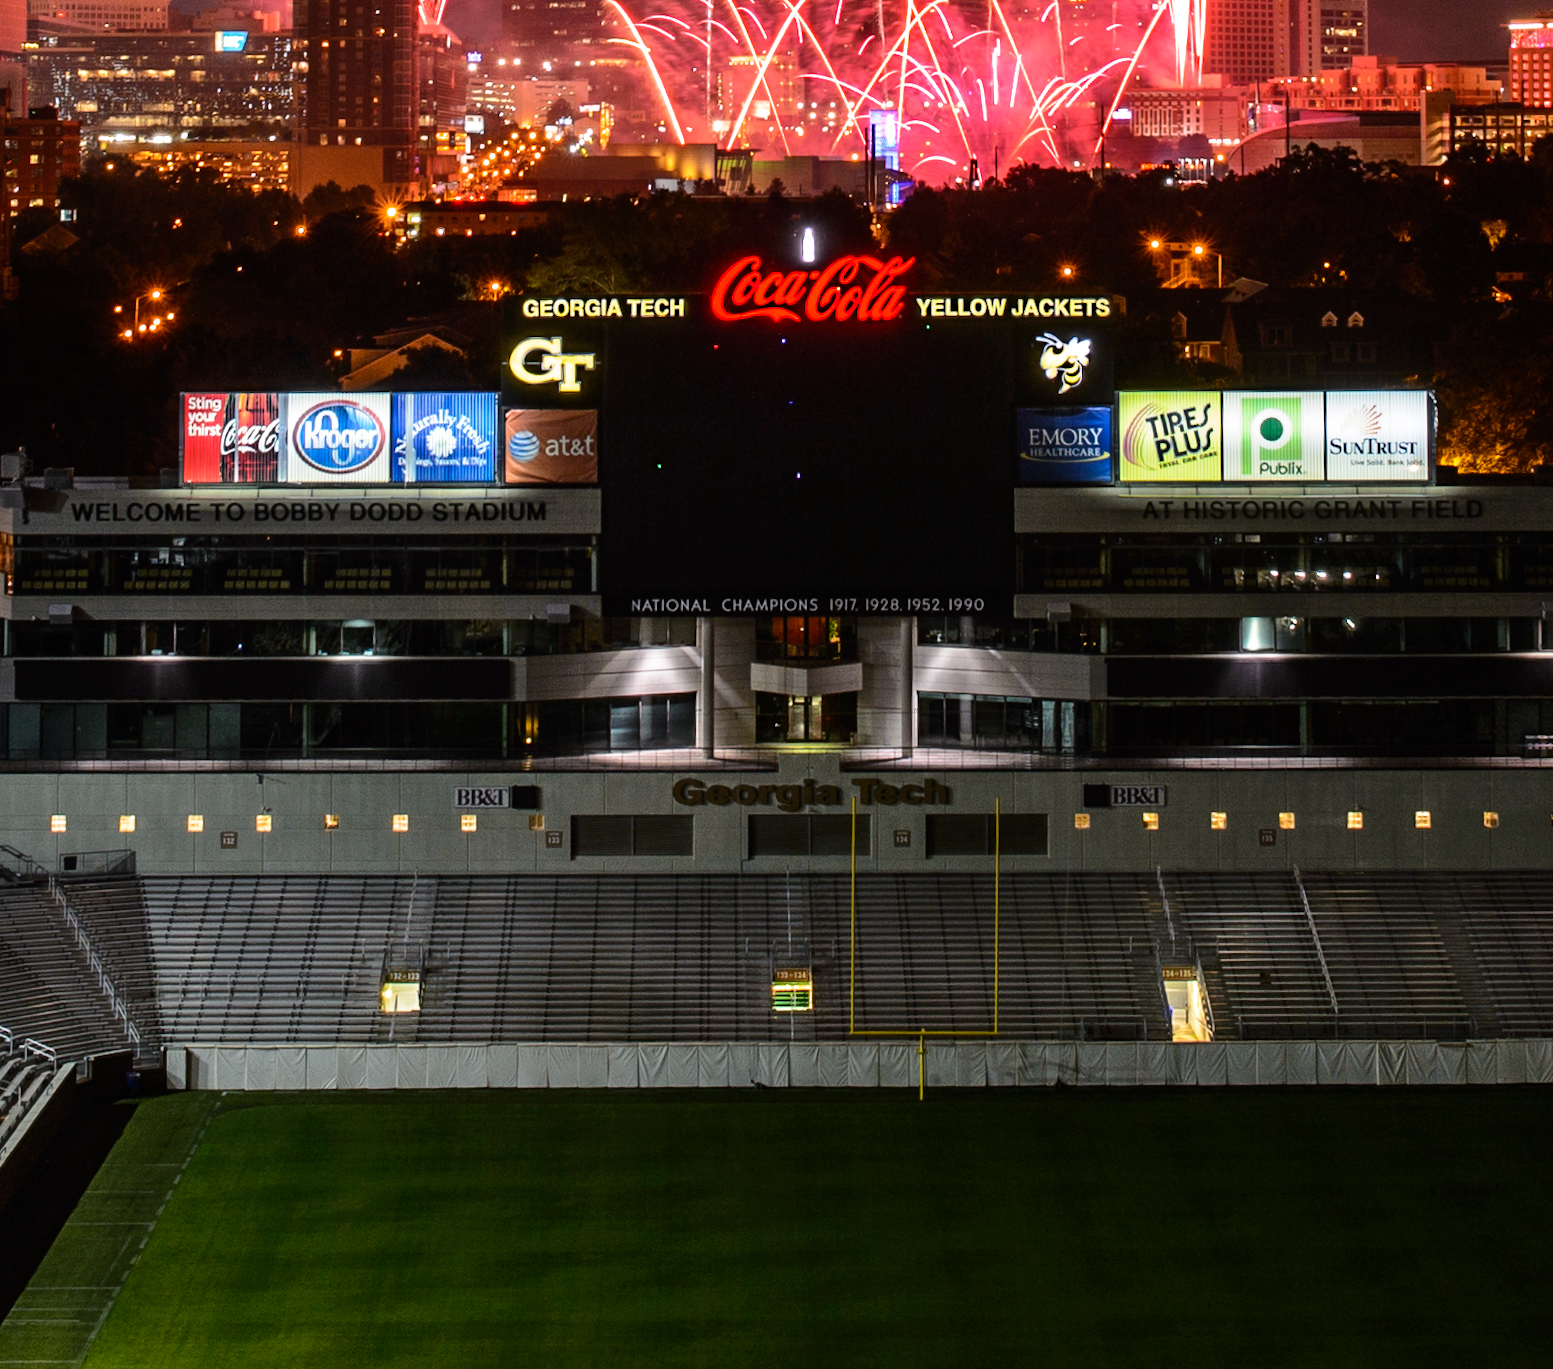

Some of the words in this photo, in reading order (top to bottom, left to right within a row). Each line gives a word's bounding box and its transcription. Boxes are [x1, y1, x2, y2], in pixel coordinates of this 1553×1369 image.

[711, 255, 916, 322] Coca-Cola
[523, 298, 623, 318] GEORGIA
[627, 298, 685, 318] TECH
[916, 298, 1007, 318] YELLOW
[1011, 298, 1111, 318] JACKETS
[509, 336, 596, 393] GT
[188, 397, 222, 411] Sting
[188, 412, 216, 425] your
[1146, 403, 1211, 439] TIRES
[188, 423, 222, 437] thirst
[305, 410, 379, 466] Kroger
[456, 414, 490, 455] Fresh
[1029, 428, 1103, 446] EMORY
[545, 435, 594, 456] at&t
[1030, 447, 1101, 457] HEALTHCARE
[1155, 427, 1214, 462] PLUS
[1260, 462, 1303, 475] Publix
[72, 503, 200, 521] WELCOME
[210, 503, 245, 521] TO
[254, 503, 339, 521] BOBBY
[350, 503, 423, 521] DODD
[432, 502, 547, 521] STADIUM
[1142, 500, 1174, 519] AT
[1183, 500, 1304, 519] HISTORIC
[1315, 500, 1402, 519] GRANT
[1411, 500, 1484, 519] FIELD
[631, 598, 711, 612] NATIONAL
[721, 598, 818, 612] CHAMPIONS
[948, 598, 985, 612] 1990
[457, 788, 507, 806] BB&T
[673, 777, 842, 812] Georgia
[851, 778, 950, 806] Tech
[1113, 787, 1164, 804] BB&T
[223, 837, 235, 845] 132
